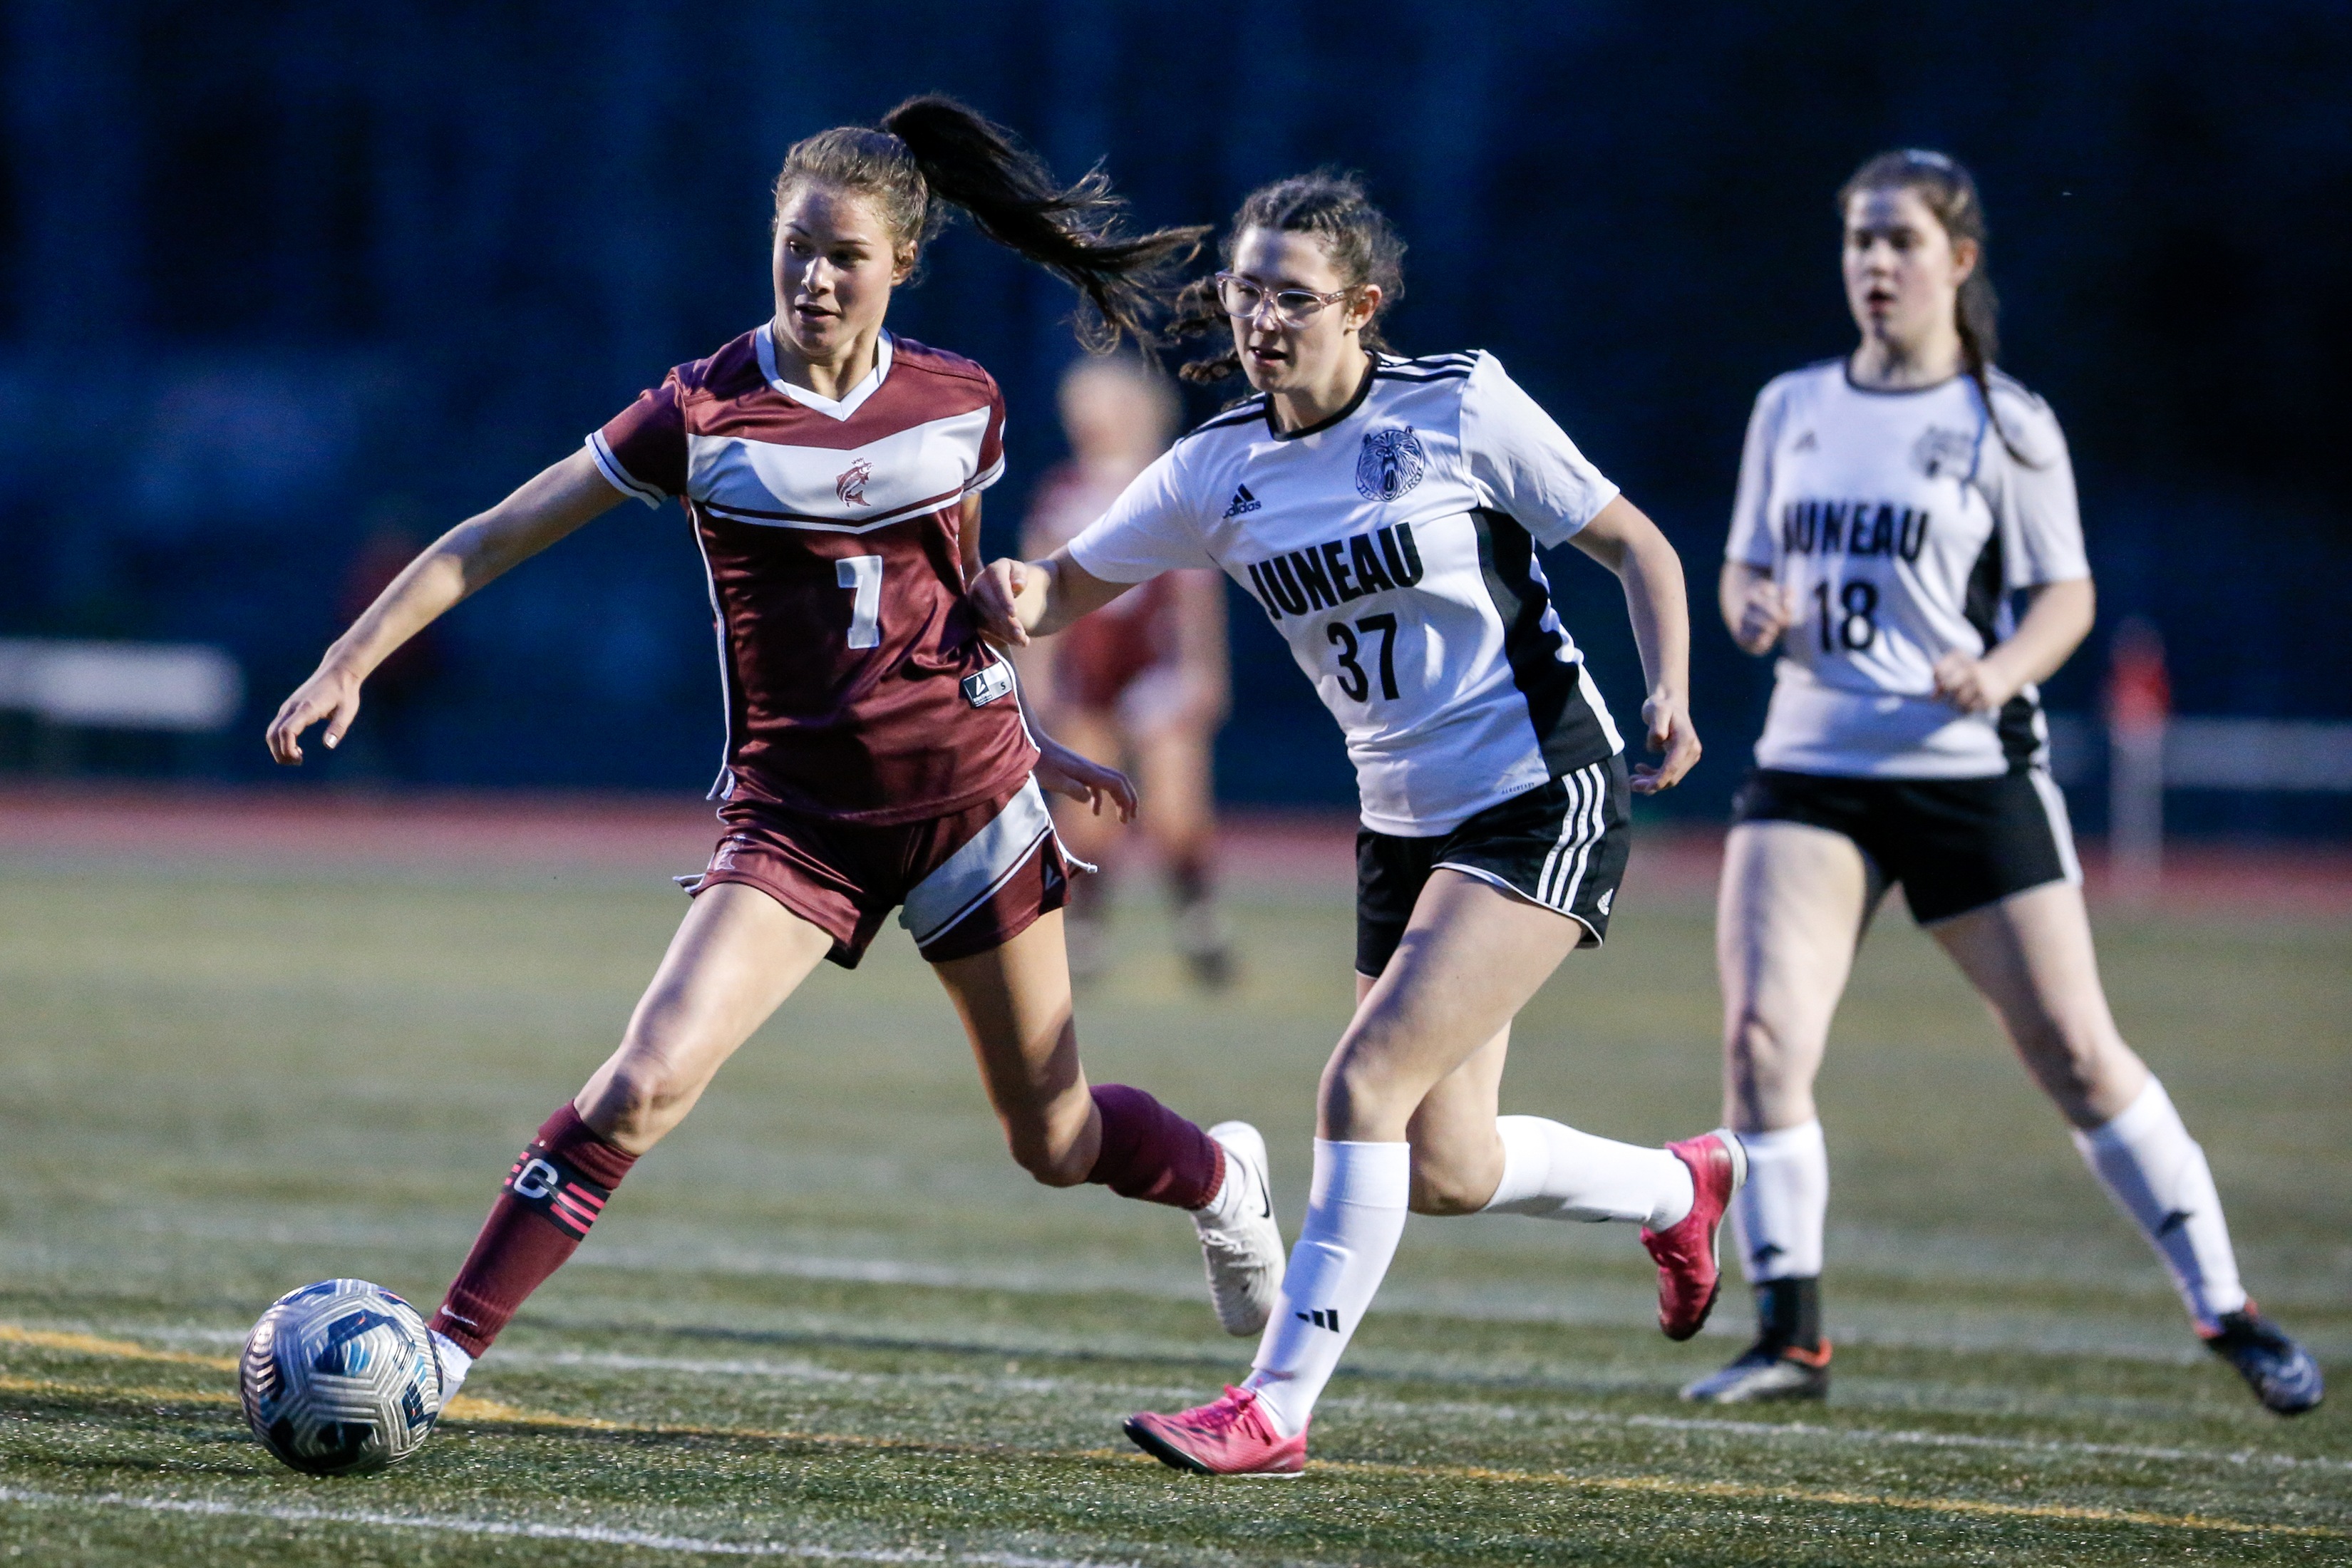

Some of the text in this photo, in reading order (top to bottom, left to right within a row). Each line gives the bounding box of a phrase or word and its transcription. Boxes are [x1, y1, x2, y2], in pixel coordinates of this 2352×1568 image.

[835, 555, 882, 649] 7
[1248, 522, 1424, 620] JUNEAU
[1815, 580, 1878, 652] 18
[1000, 681, 1006, 691] S
[1327, 612, 1400, 703] 37
[513, 1158, 558, 1199] C
